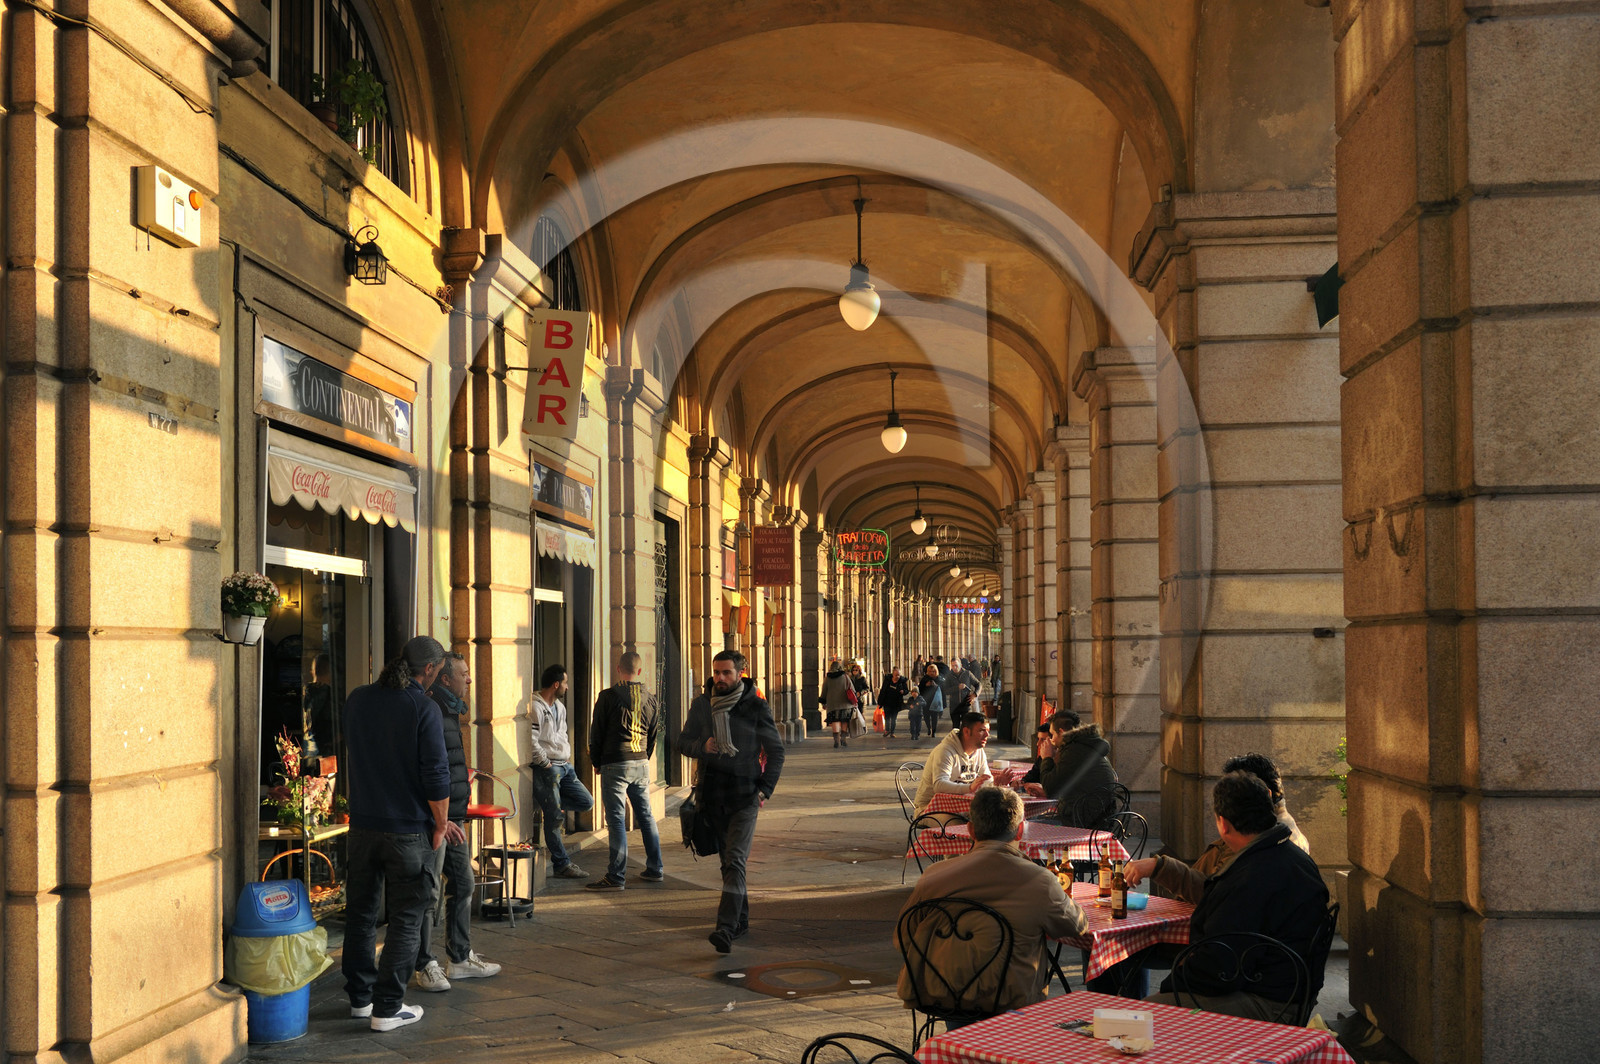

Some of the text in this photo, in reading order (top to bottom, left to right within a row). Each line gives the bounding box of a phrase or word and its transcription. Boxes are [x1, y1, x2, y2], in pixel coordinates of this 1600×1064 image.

[537, 319, 574, 426] BAR
[292, 465, 331, 499] Coca-Cola
[366, 485, 398, 514] Coca-Cola
[837, 531, 887, 546] TRATTORIA
[265, 894, 288, 905] Motta
